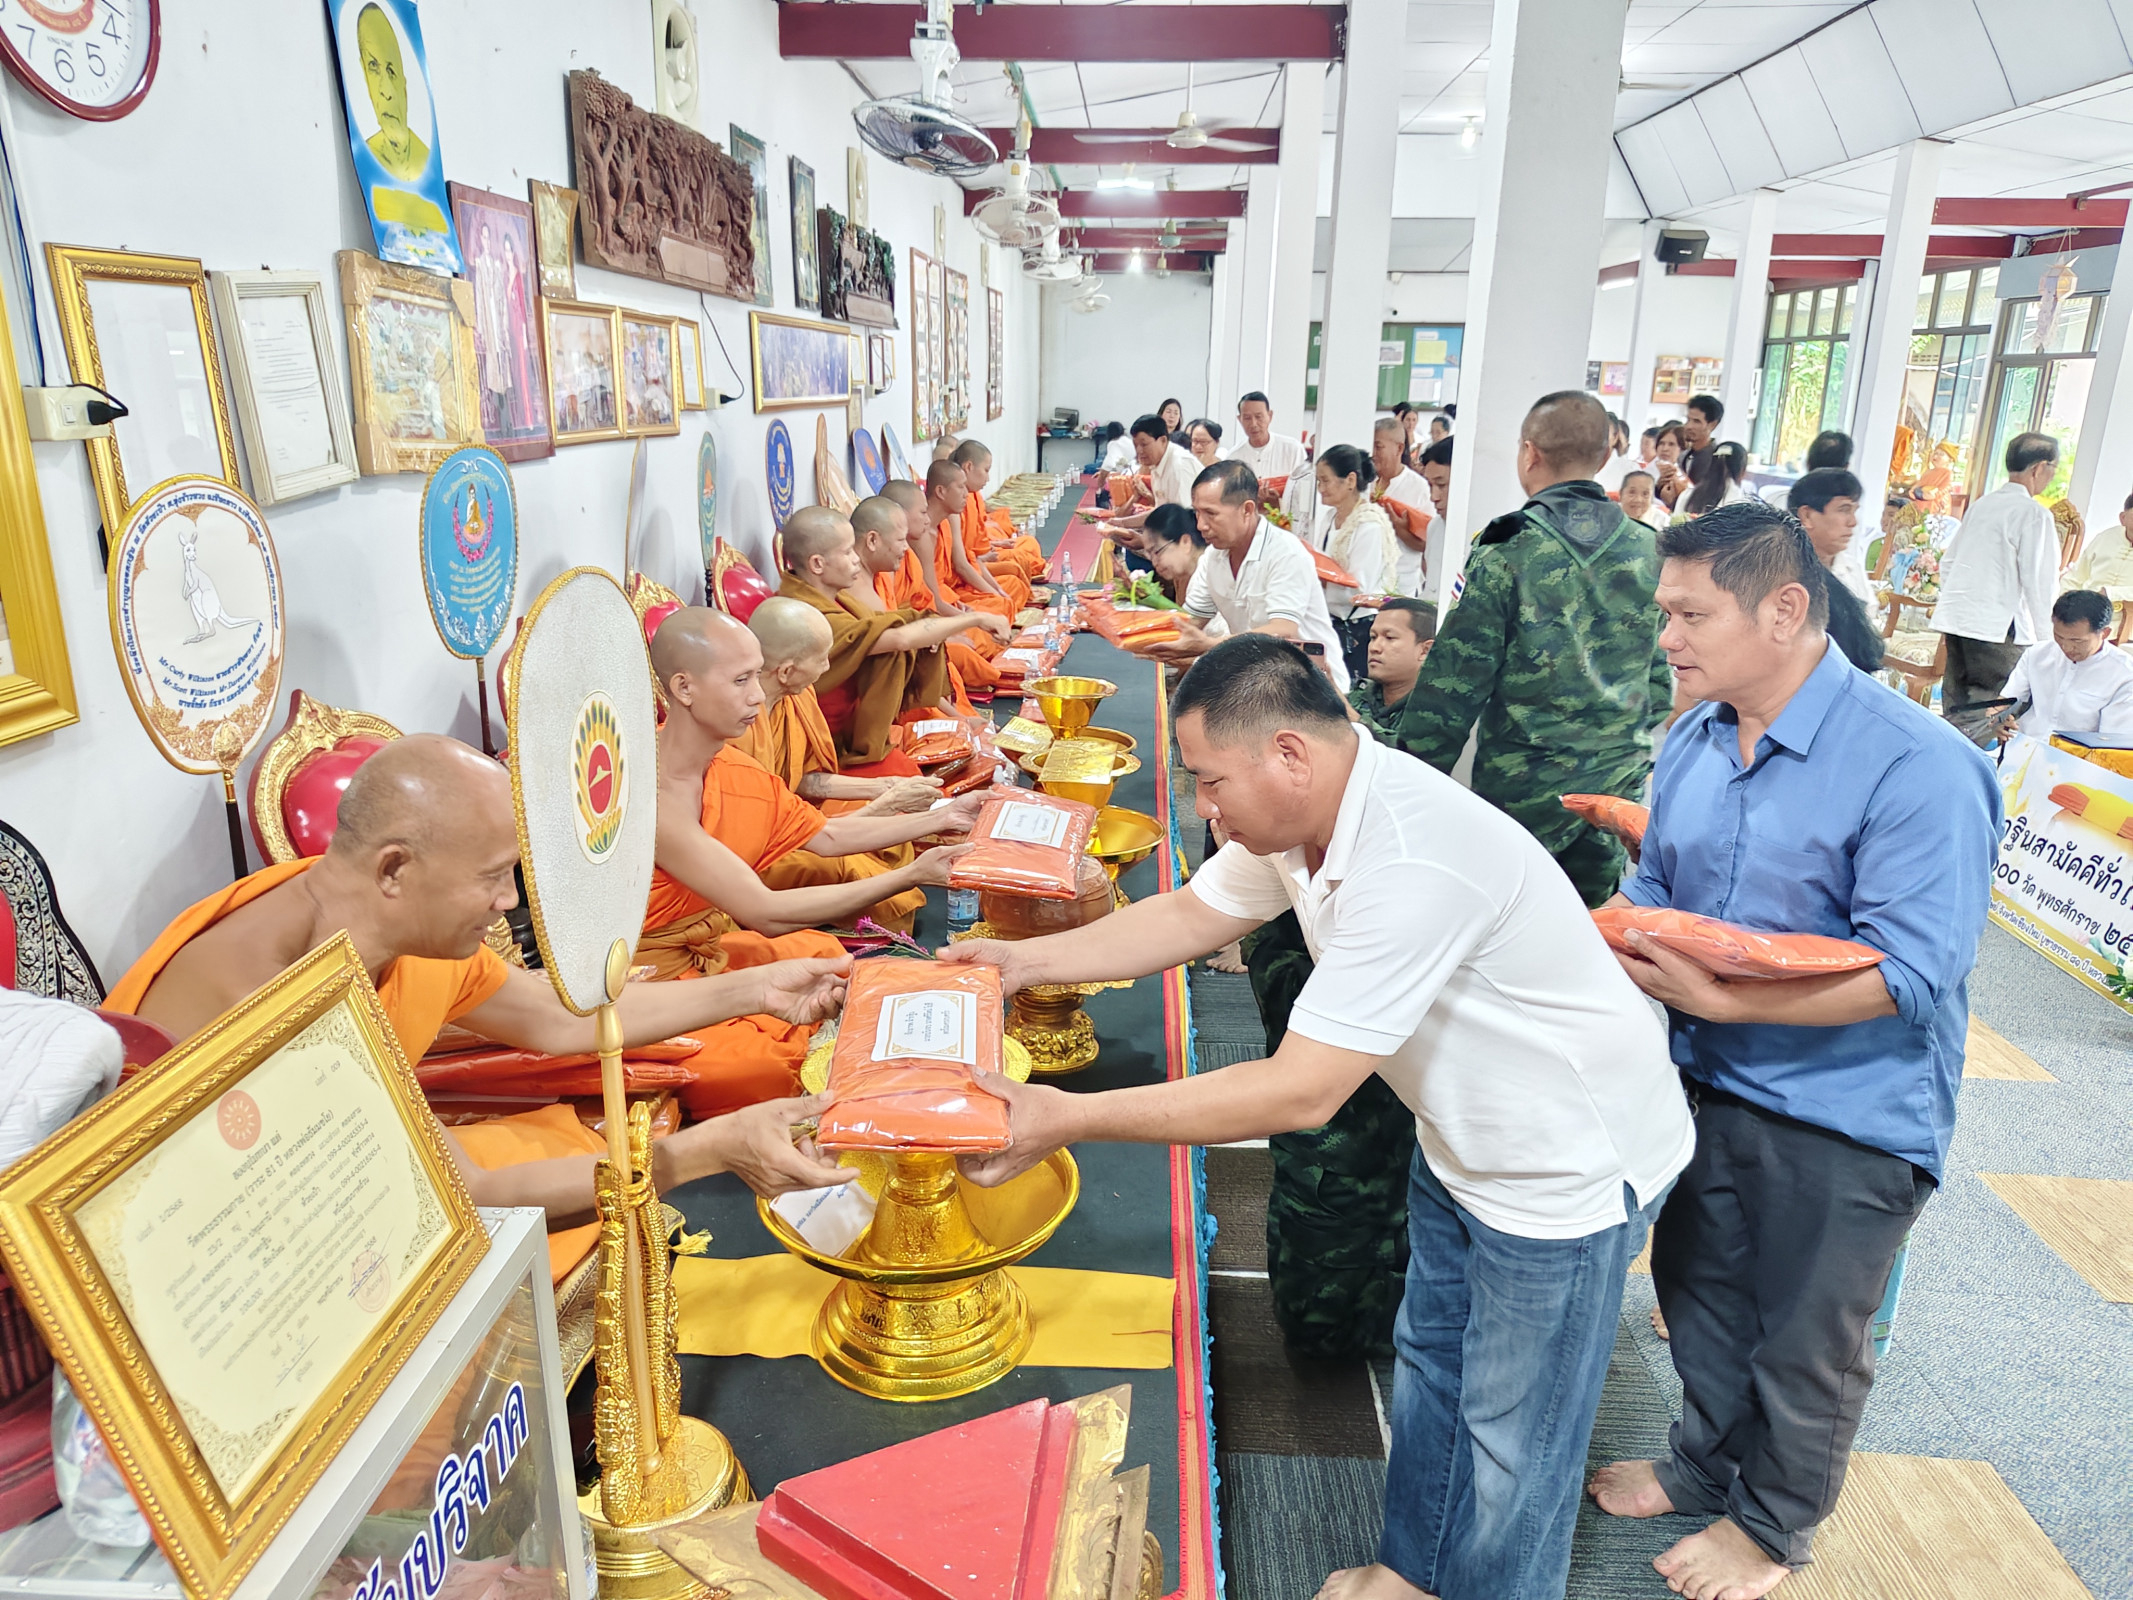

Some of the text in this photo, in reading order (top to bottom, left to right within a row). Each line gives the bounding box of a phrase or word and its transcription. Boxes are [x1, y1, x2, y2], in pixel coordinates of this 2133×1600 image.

[16, 23, 35, 59] 7
[102, 13, 122, 45] 4
[54, 48, 75, 83] 6
[86, 42, 105, 77] 5
[2022, 873, 2036, 896] วัด
[2037, 888, 2101, 936] พุทธศักราช
[341, 1380, 530, 1600] บริจาค
